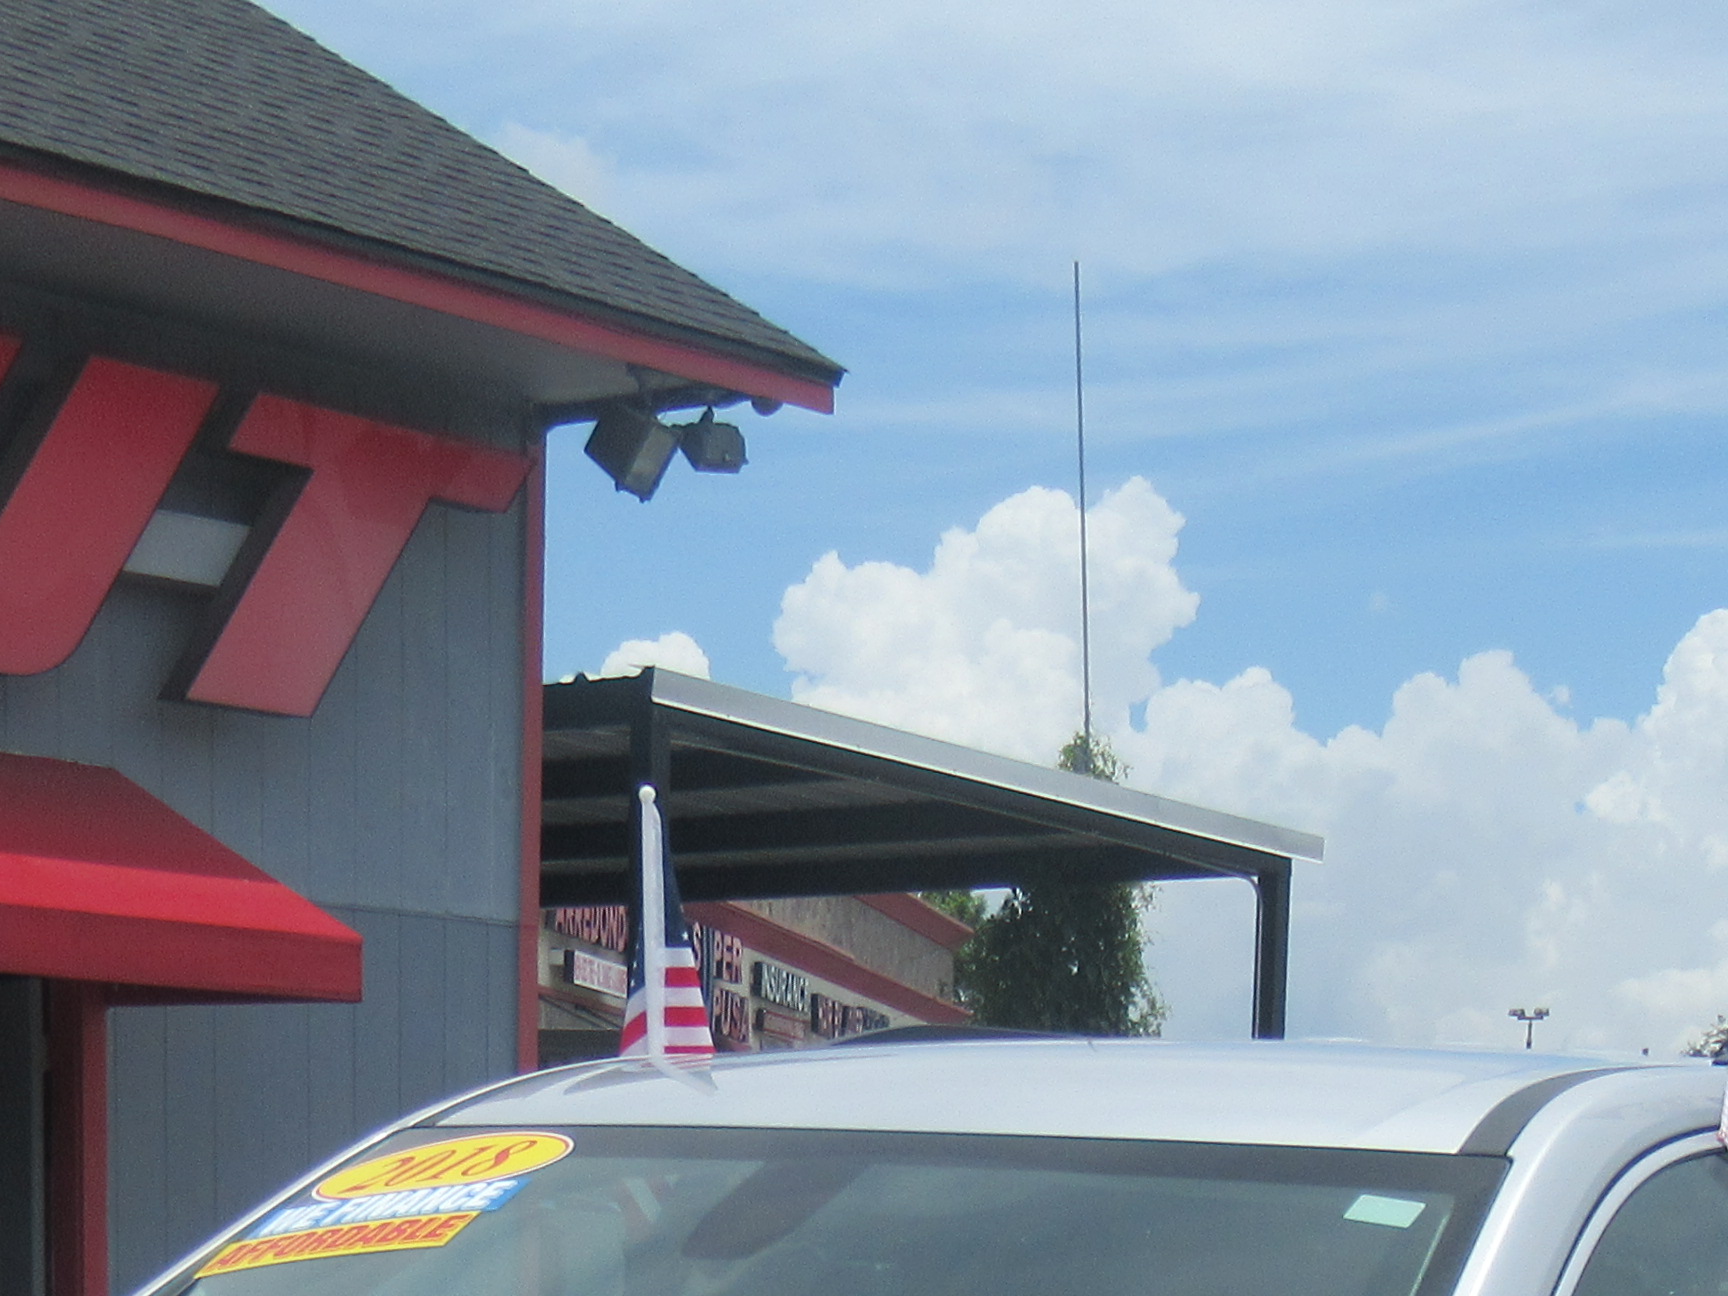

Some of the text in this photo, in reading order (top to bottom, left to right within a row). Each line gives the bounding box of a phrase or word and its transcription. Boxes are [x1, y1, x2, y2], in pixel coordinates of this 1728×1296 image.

[693, 921, 742, 984] SPER
[346, 1139, 538, 1197] 2018
[257, 1180, 519, 1237] WE FINANCE
[204, 1213, 470, 1271] AFFORDABLE
